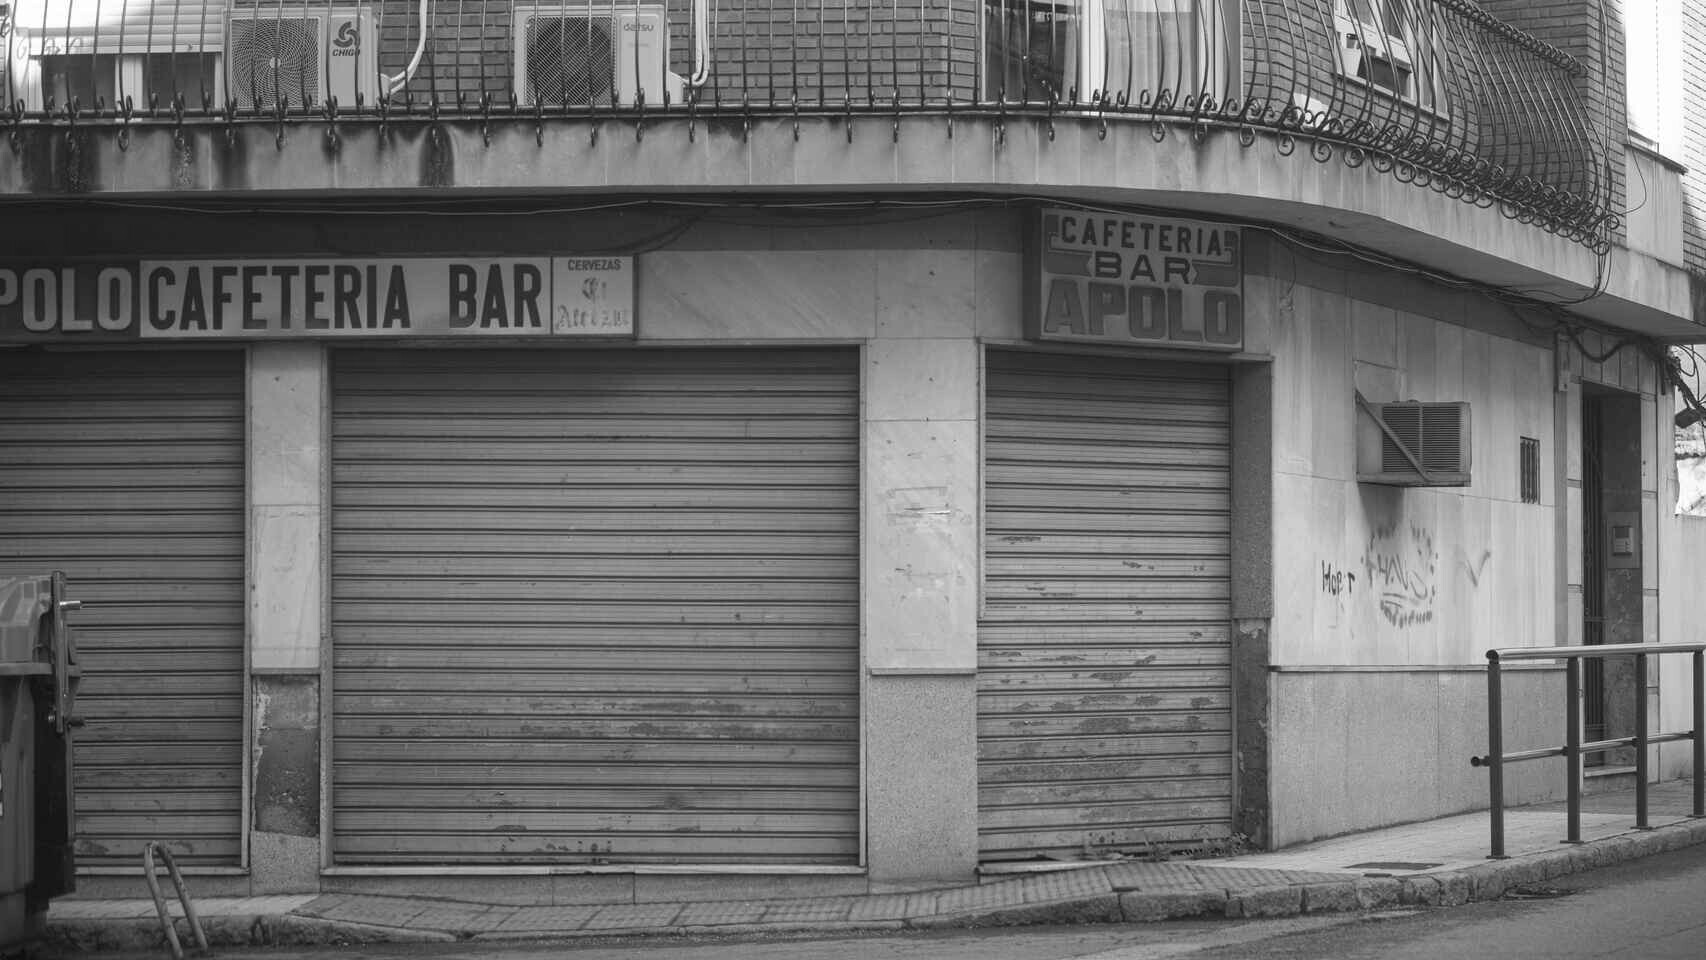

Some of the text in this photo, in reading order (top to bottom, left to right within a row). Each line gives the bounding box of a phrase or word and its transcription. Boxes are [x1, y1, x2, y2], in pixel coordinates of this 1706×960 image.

[1061, 216, 1222, 257] CAFETERIA
[567, 258, 622, 271] CERVEZAS
[1095, 251, 1192, 285] BAR
[149, 263, 542, 331] CAFETERIA BAR
[1043, 279, 1241, 345] APOLO
